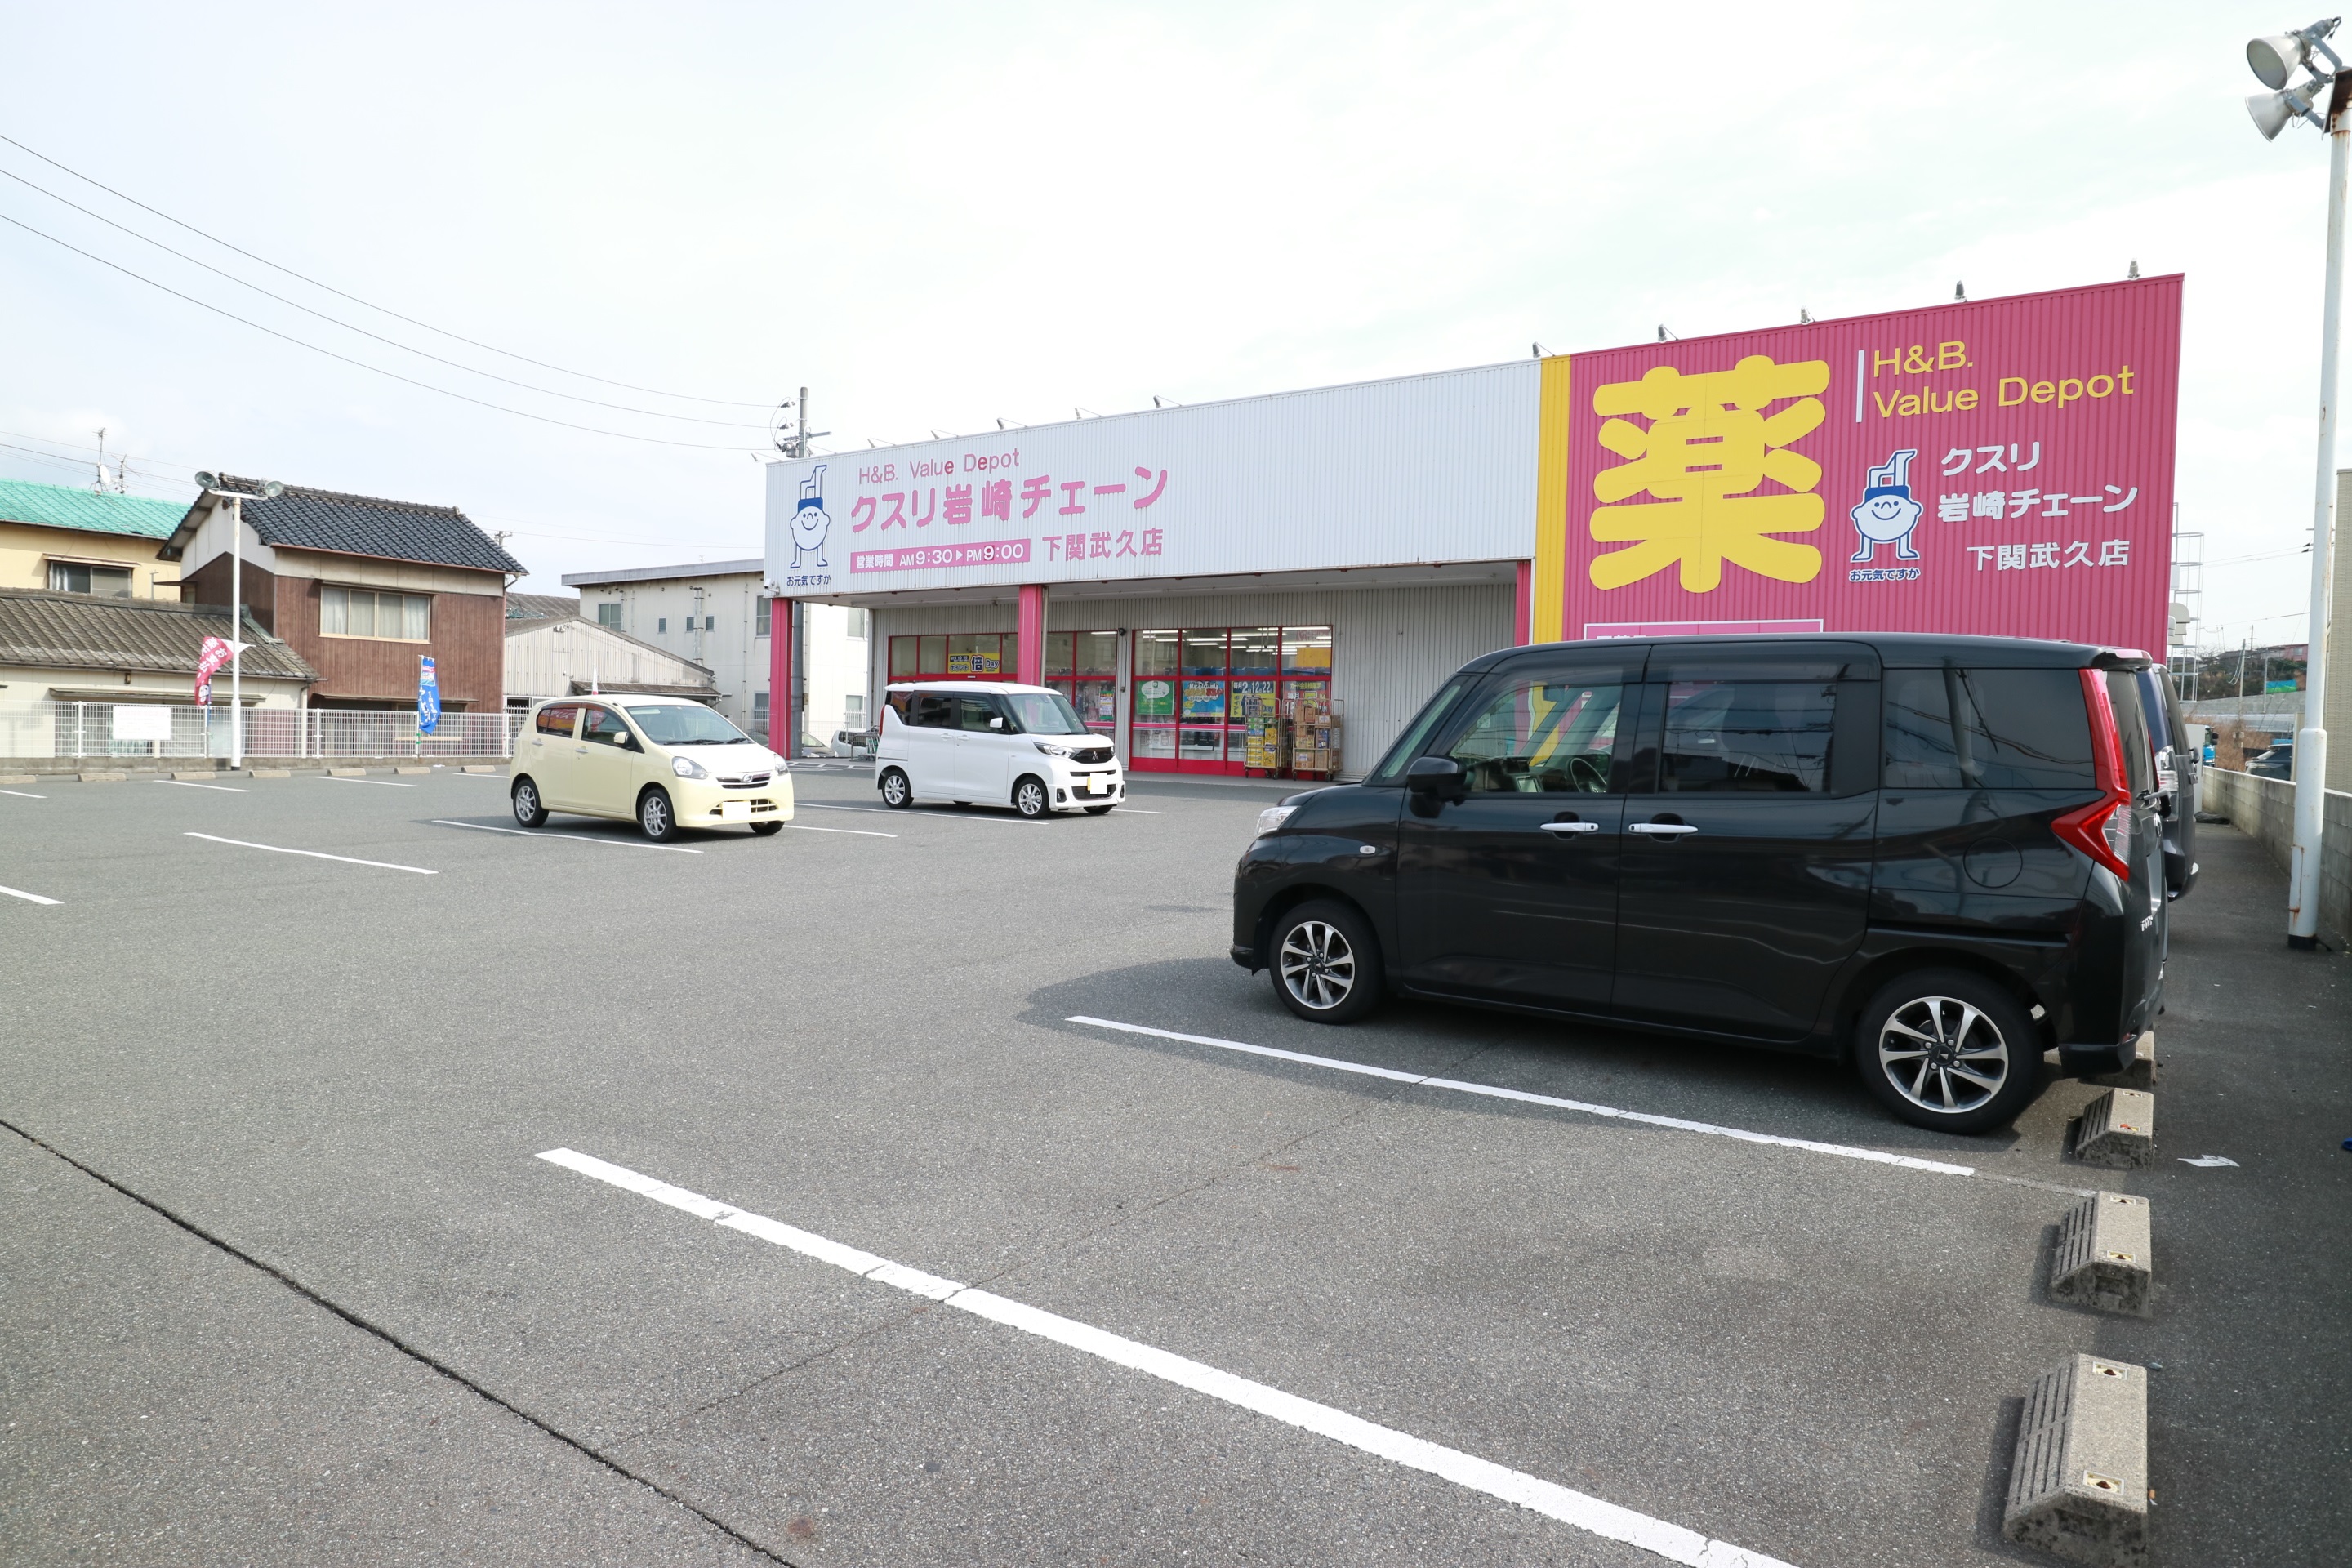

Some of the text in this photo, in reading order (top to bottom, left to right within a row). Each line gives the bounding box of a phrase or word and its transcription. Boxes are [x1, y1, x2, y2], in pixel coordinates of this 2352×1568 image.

[1873, 341, 1973, 377] H&B.
[1873, 365, 2134, 418] Value Depot
[859, 448, 1019, 484] H&B. Value Depot
[1589, 354, 1830, 593] 薬
[1940, 442, 2040, 476] クスリ
[851, 466, 1168, 533] クスリ岩崎チェーン
[1937, 484, 2138, 522] 岩崎チェーン
[856, 553, 893, 569] 営業時間
[1042, 528, 1163, 562] 下関武久店
[1967, 539, 2130, 571] 下関武久店
[786, 574, 831, 586] お元気ですか
[1849, 568, 1920, 582] お元気ですか
[972, 656, 983, 671] 倍
[986, 660, 999, 669] Day
